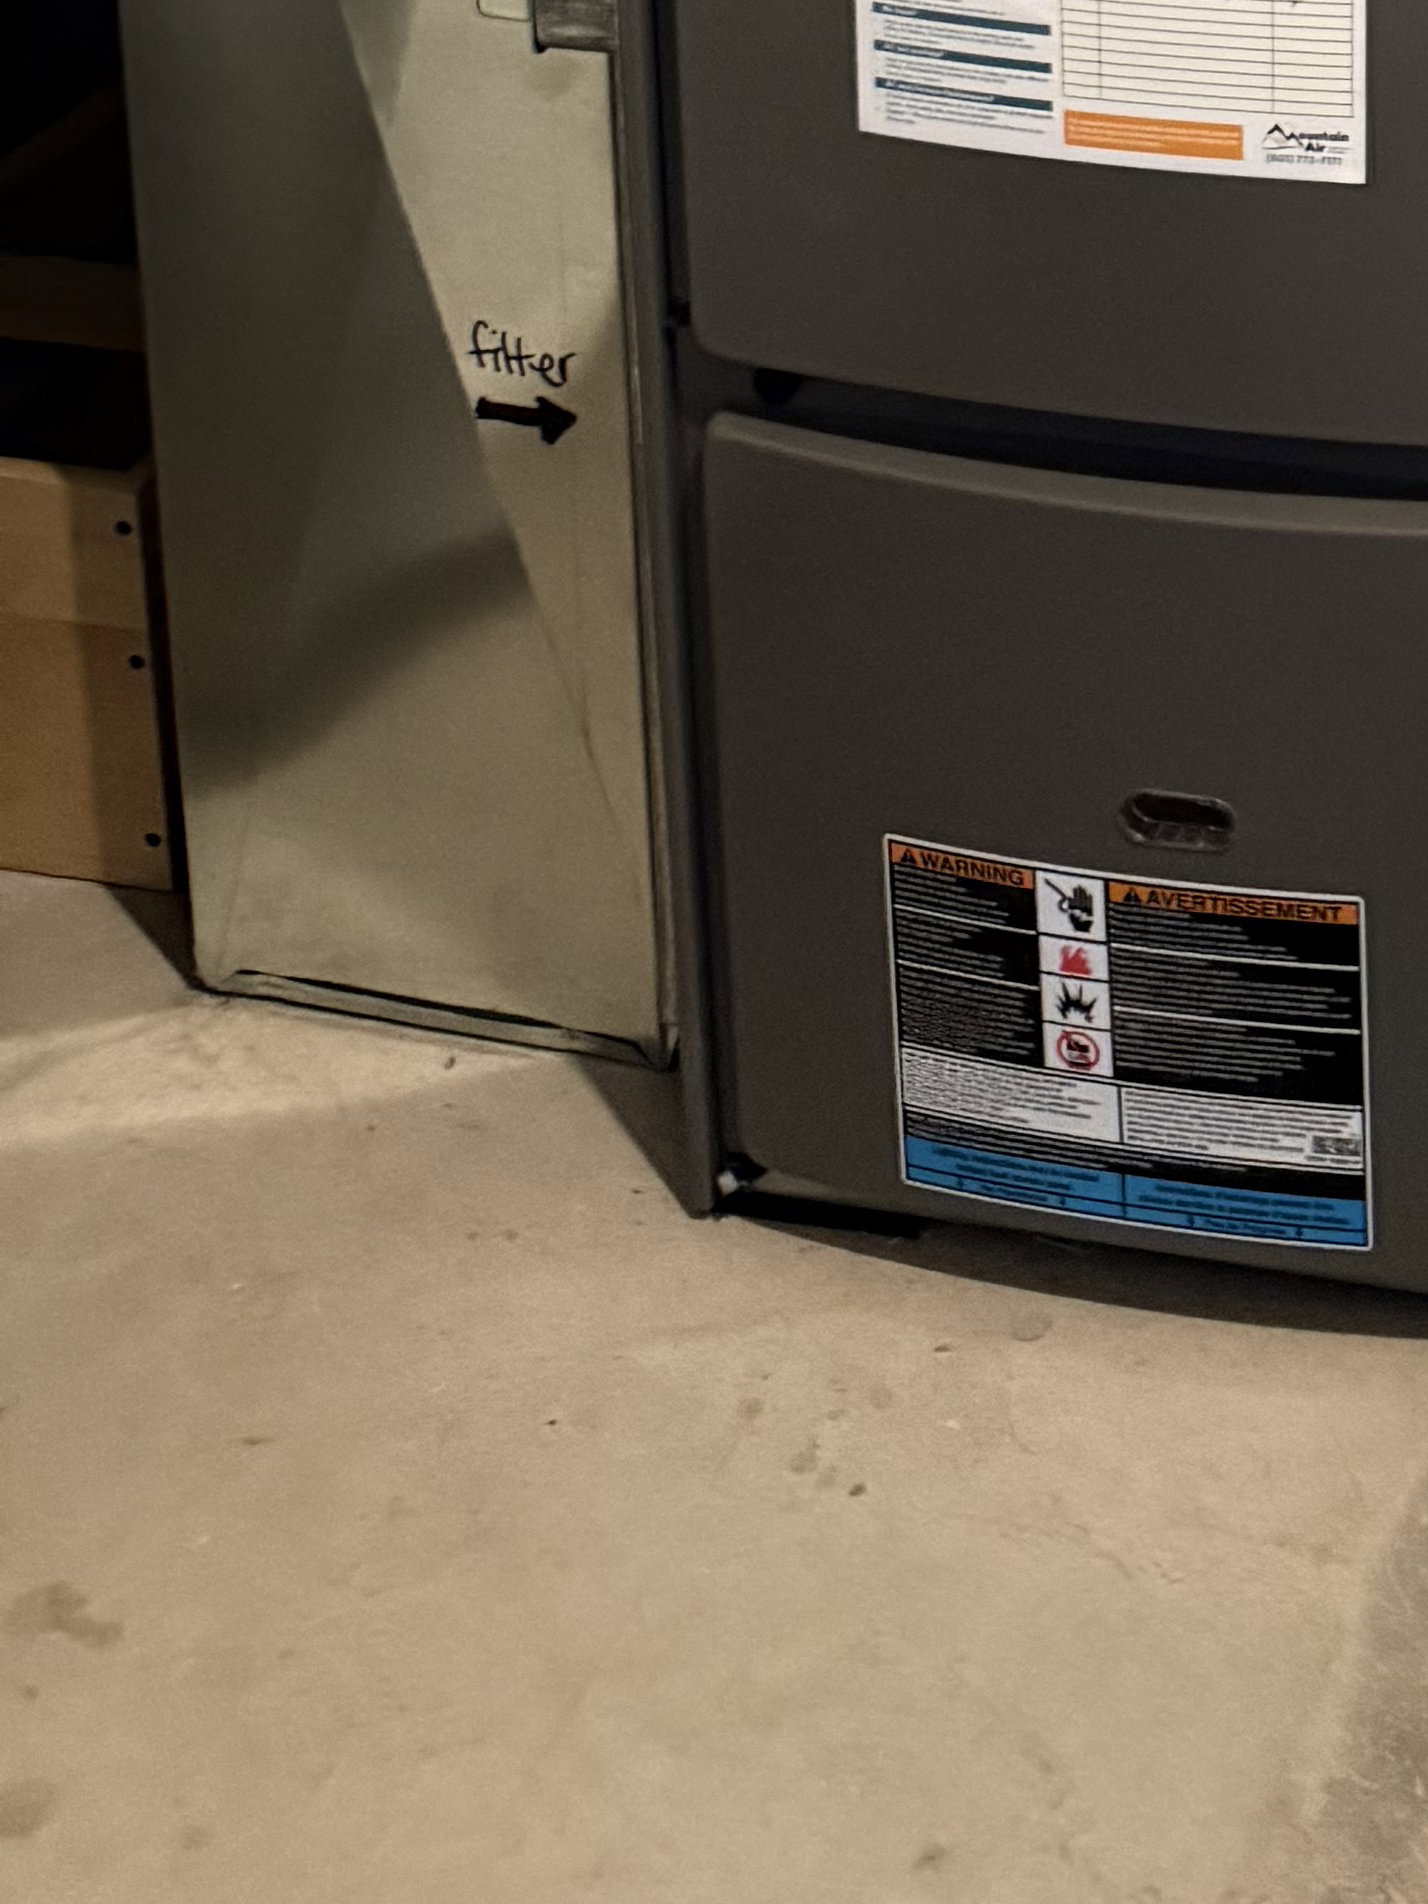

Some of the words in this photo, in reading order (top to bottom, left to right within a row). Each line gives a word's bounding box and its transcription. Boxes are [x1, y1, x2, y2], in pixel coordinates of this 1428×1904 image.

[1304, 142, 1326, 152] Air
[468, 320, 576, 387] filter
[920, 851, 1025, 887] WARNING
[1146, 889, 1342, 923] AVERTISSEMENT
